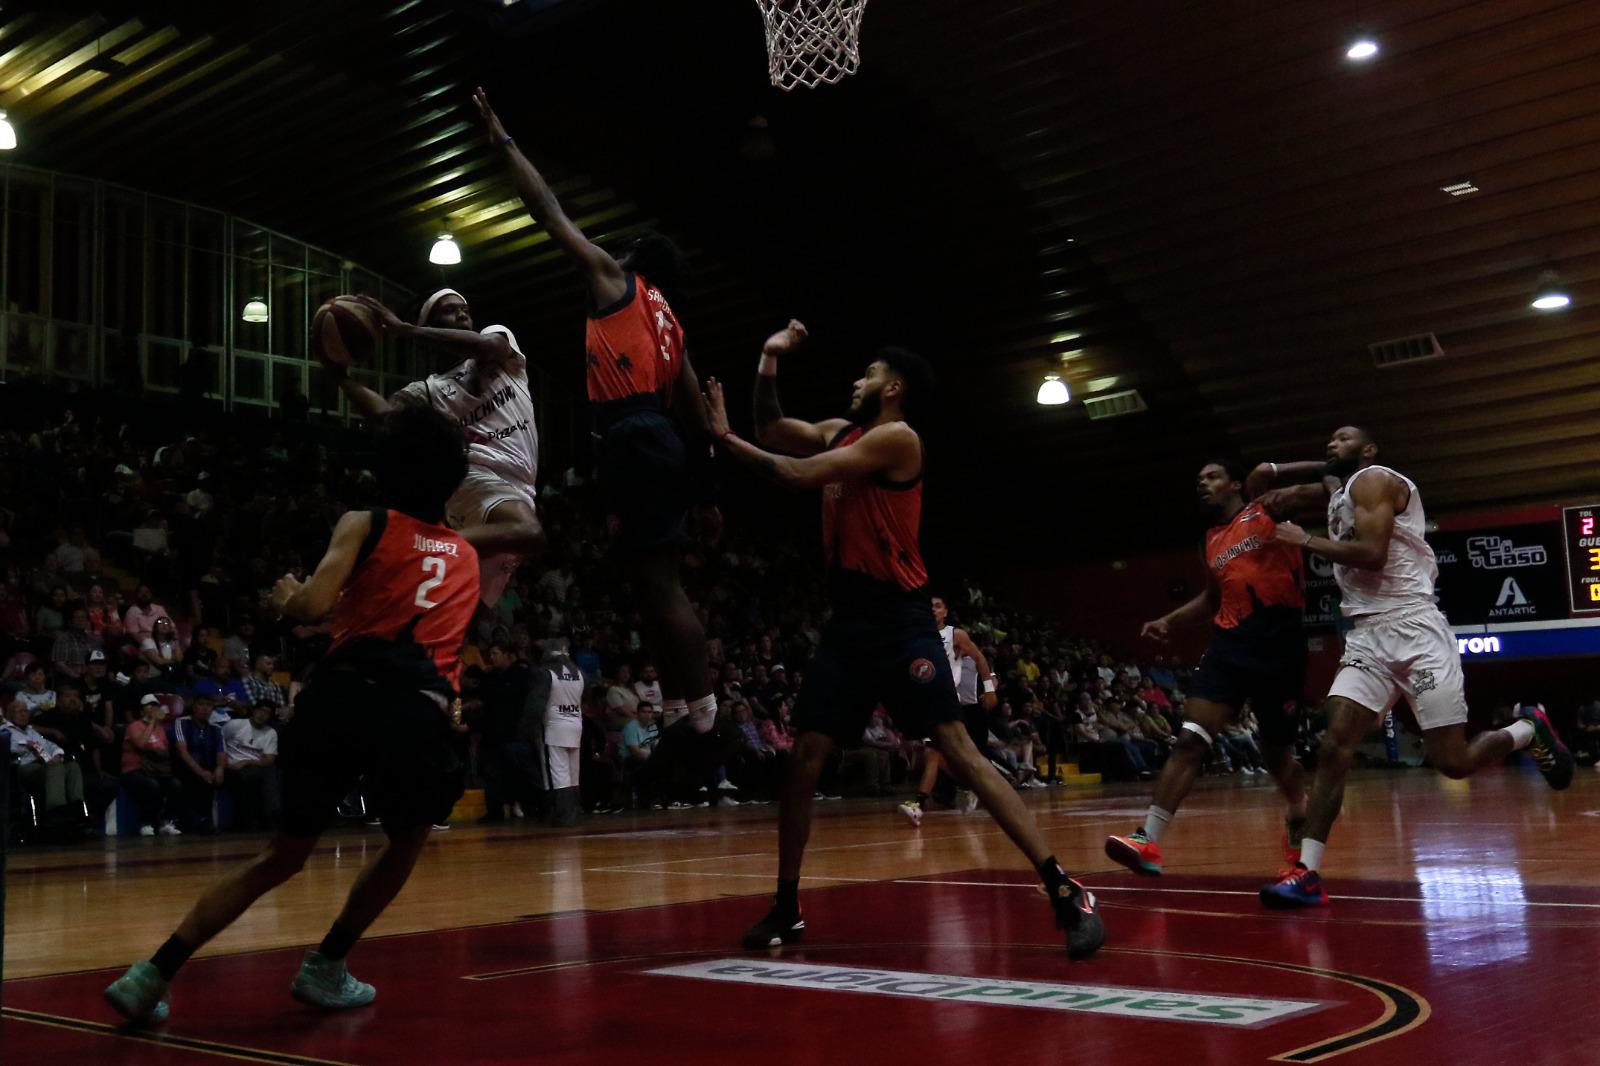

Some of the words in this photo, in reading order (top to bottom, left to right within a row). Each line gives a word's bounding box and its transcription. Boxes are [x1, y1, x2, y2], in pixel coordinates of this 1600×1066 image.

[1582, 517, 1594, 535] 2
[413, 555, 447, 610] 2
[1488, 605, 1537, 617] ANTARTIC
[1456, 636, 1500, 654] ron
